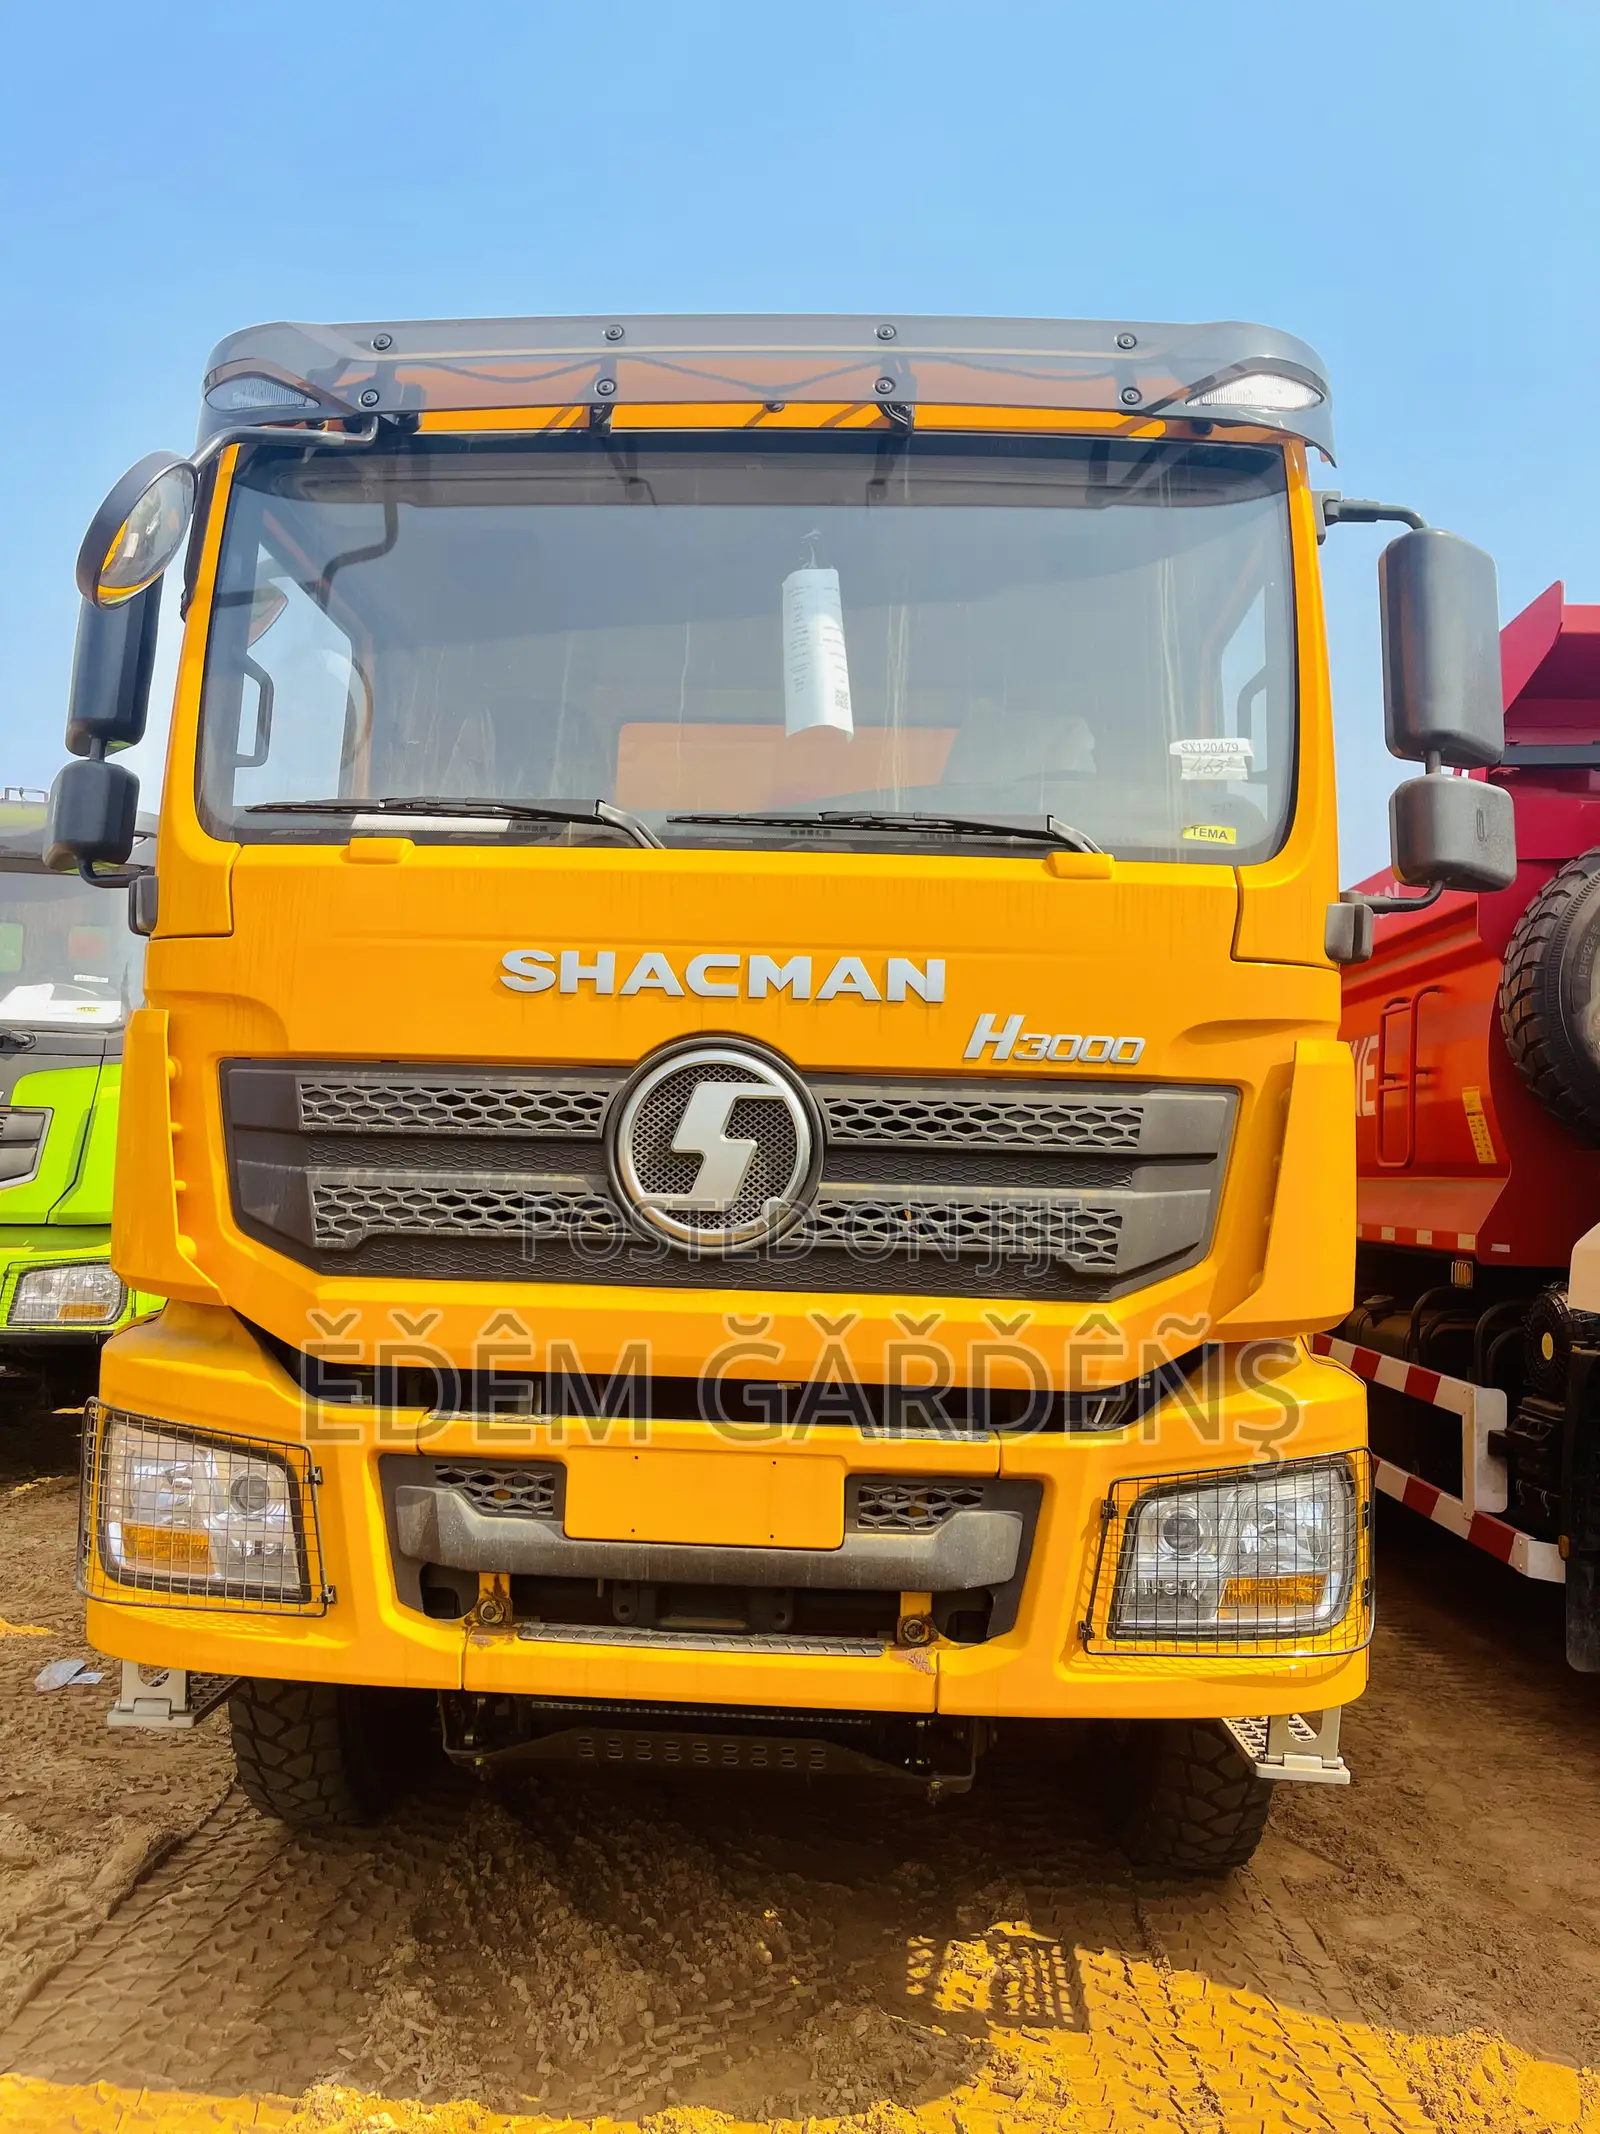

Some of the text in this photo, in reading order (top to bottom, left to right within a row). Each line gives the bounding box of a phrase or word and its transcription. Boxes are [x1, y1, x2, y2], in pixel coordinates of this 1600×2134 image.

[1181, 742, 1239, 754] SX120479
[1191, 826, 1229, 841] TEMA
[500, 949, 946, 1003] SHACMAN
[963, 1013, 1146, 1064] H3000
